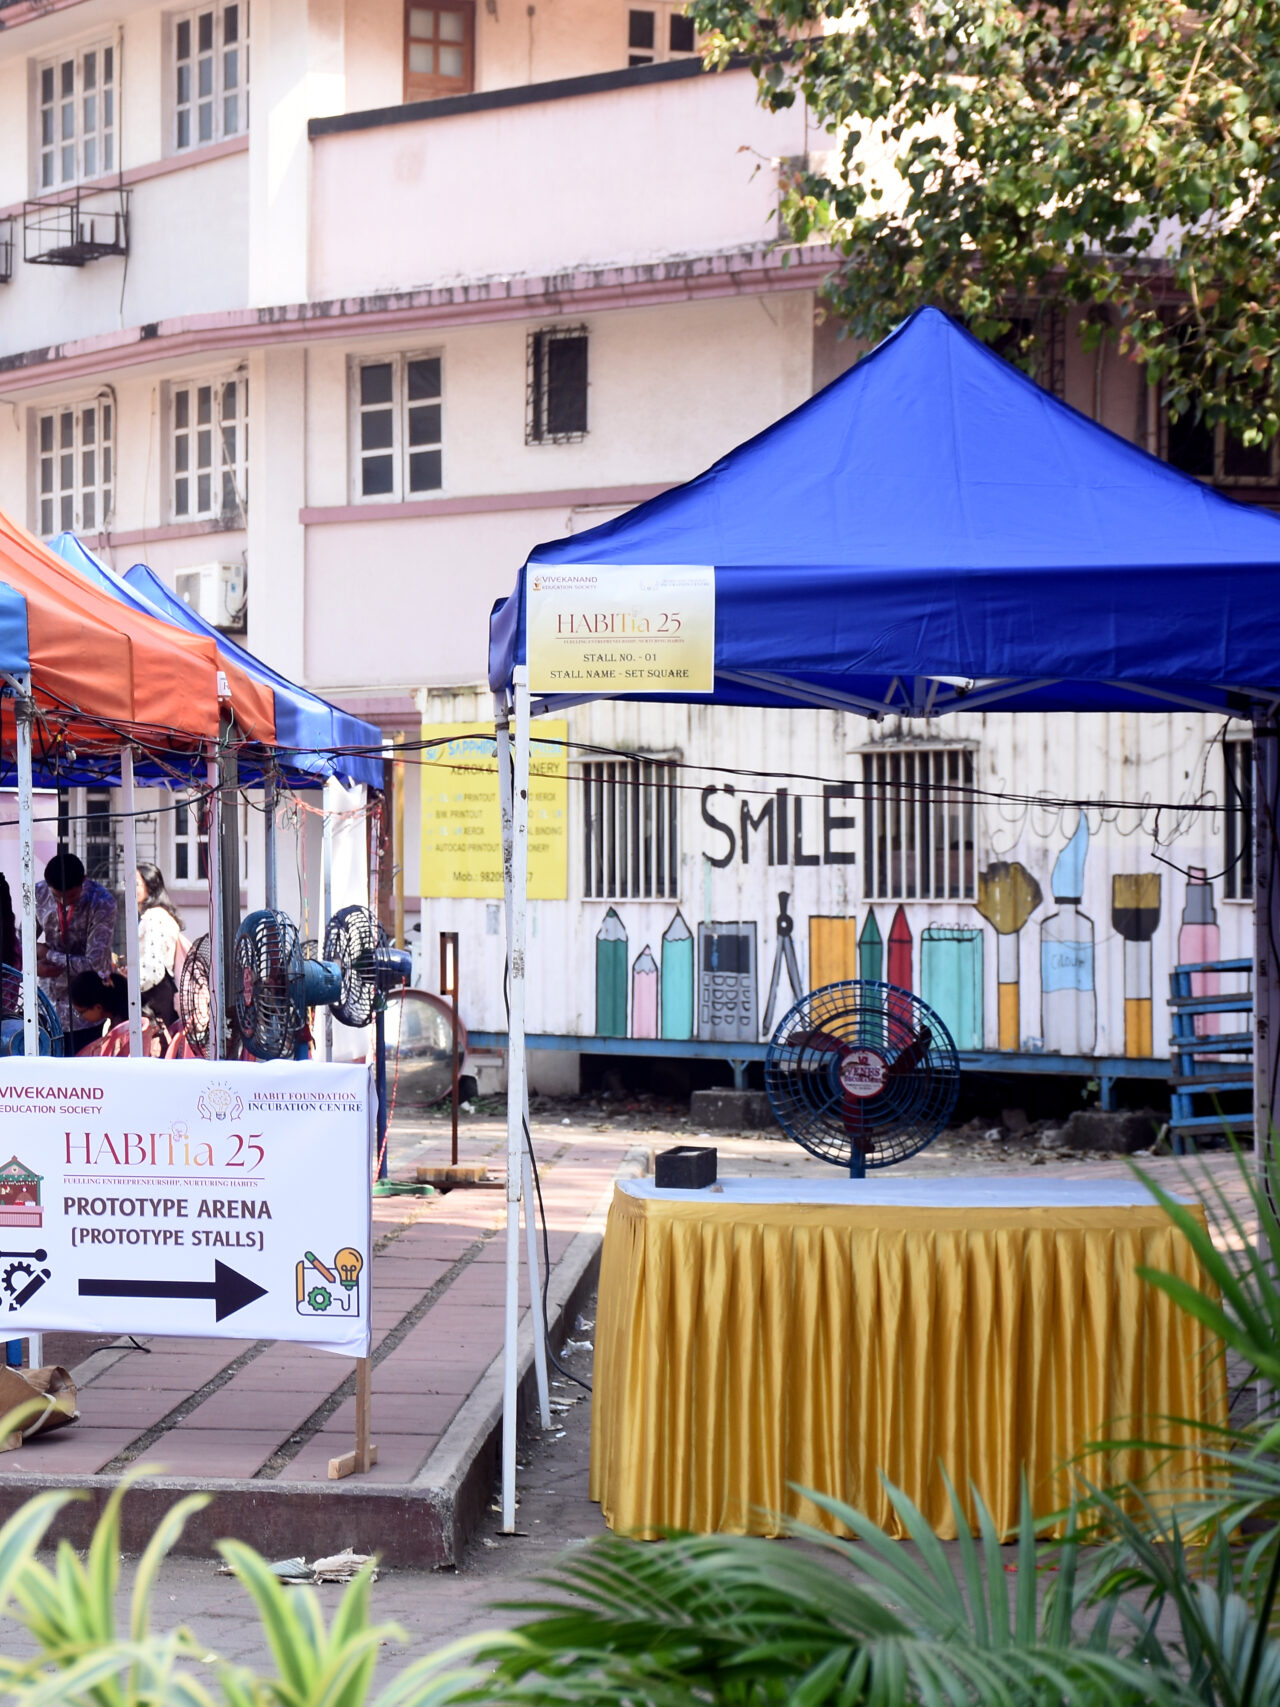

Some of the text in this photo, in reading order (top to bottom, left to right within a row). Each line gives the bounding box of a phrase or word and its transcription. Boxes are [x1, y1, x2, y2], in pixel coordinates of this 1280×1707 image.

[657, 612, 682, 635] 25
[583, 653, 617, 662] STALL
[619, 653, 636, 662] NO.
[550, 670, 583, 679] STALL
[586, 669, 616, 678] NAME
[625, 669, 644, 678] SET
[647, 669, 689, 678] SQUARE
[448, 739, 498, 757] SAPPHIR
[701, 784, 856, 868] SMILE
[253, 1092, 357, 1100] HABIT FOUNDATION
[59, 1105, 102, 1115] SOCIETY
[248, 1102, 363, 1112] INCUBATION CENTRE
[224, 1131, 266, 1173] 25
[63, 1177, 101, 1186] FUELLING
[183, 1179, 229, 1188] NURTURING
[230, 1180, 259, 1188] HABITS
[63, 1196, 273, 1220] PROTOTYPE ARENA
